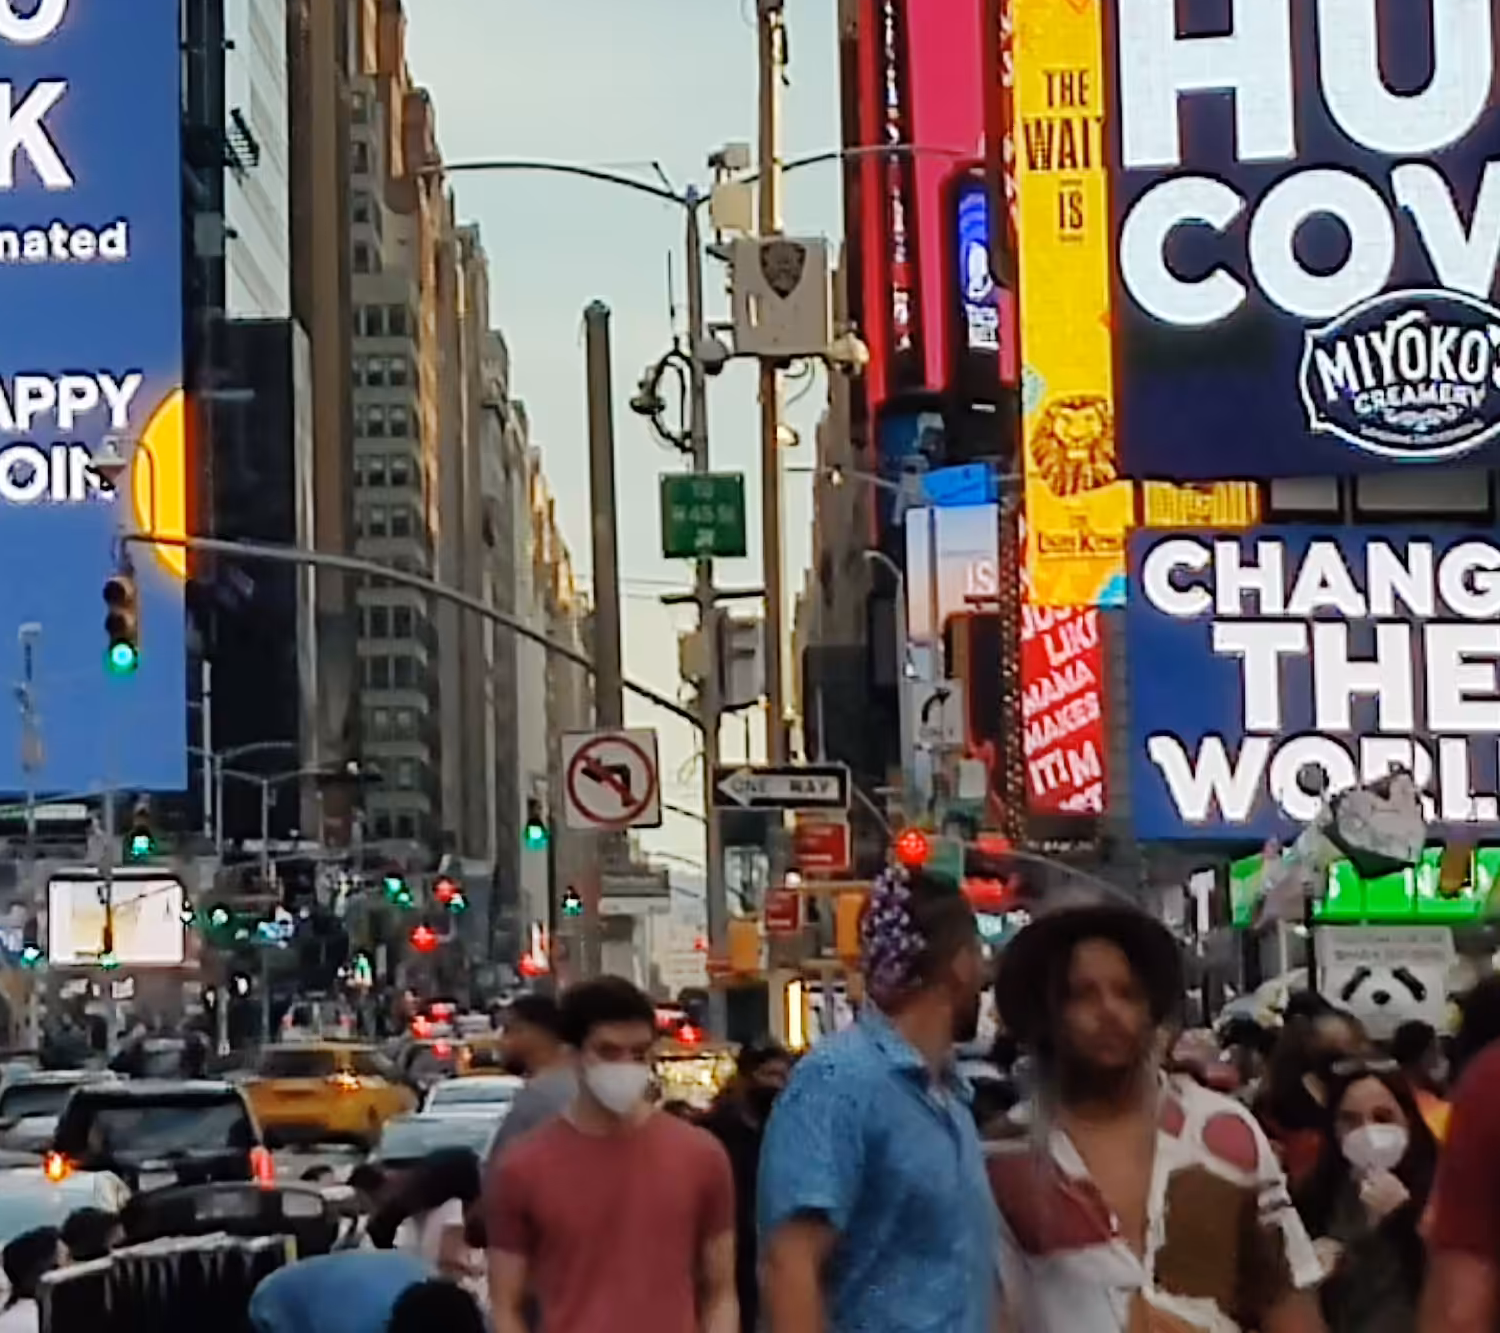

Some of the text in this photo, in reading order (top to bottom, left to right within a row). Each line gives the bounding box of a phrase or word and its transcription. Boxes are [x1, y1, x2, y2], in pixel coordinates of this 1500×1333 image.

[1043, 70, 1090, 108] THE
[1058, 191, 1084, 230] IS
[1213, 623, 1500, 733] THE
